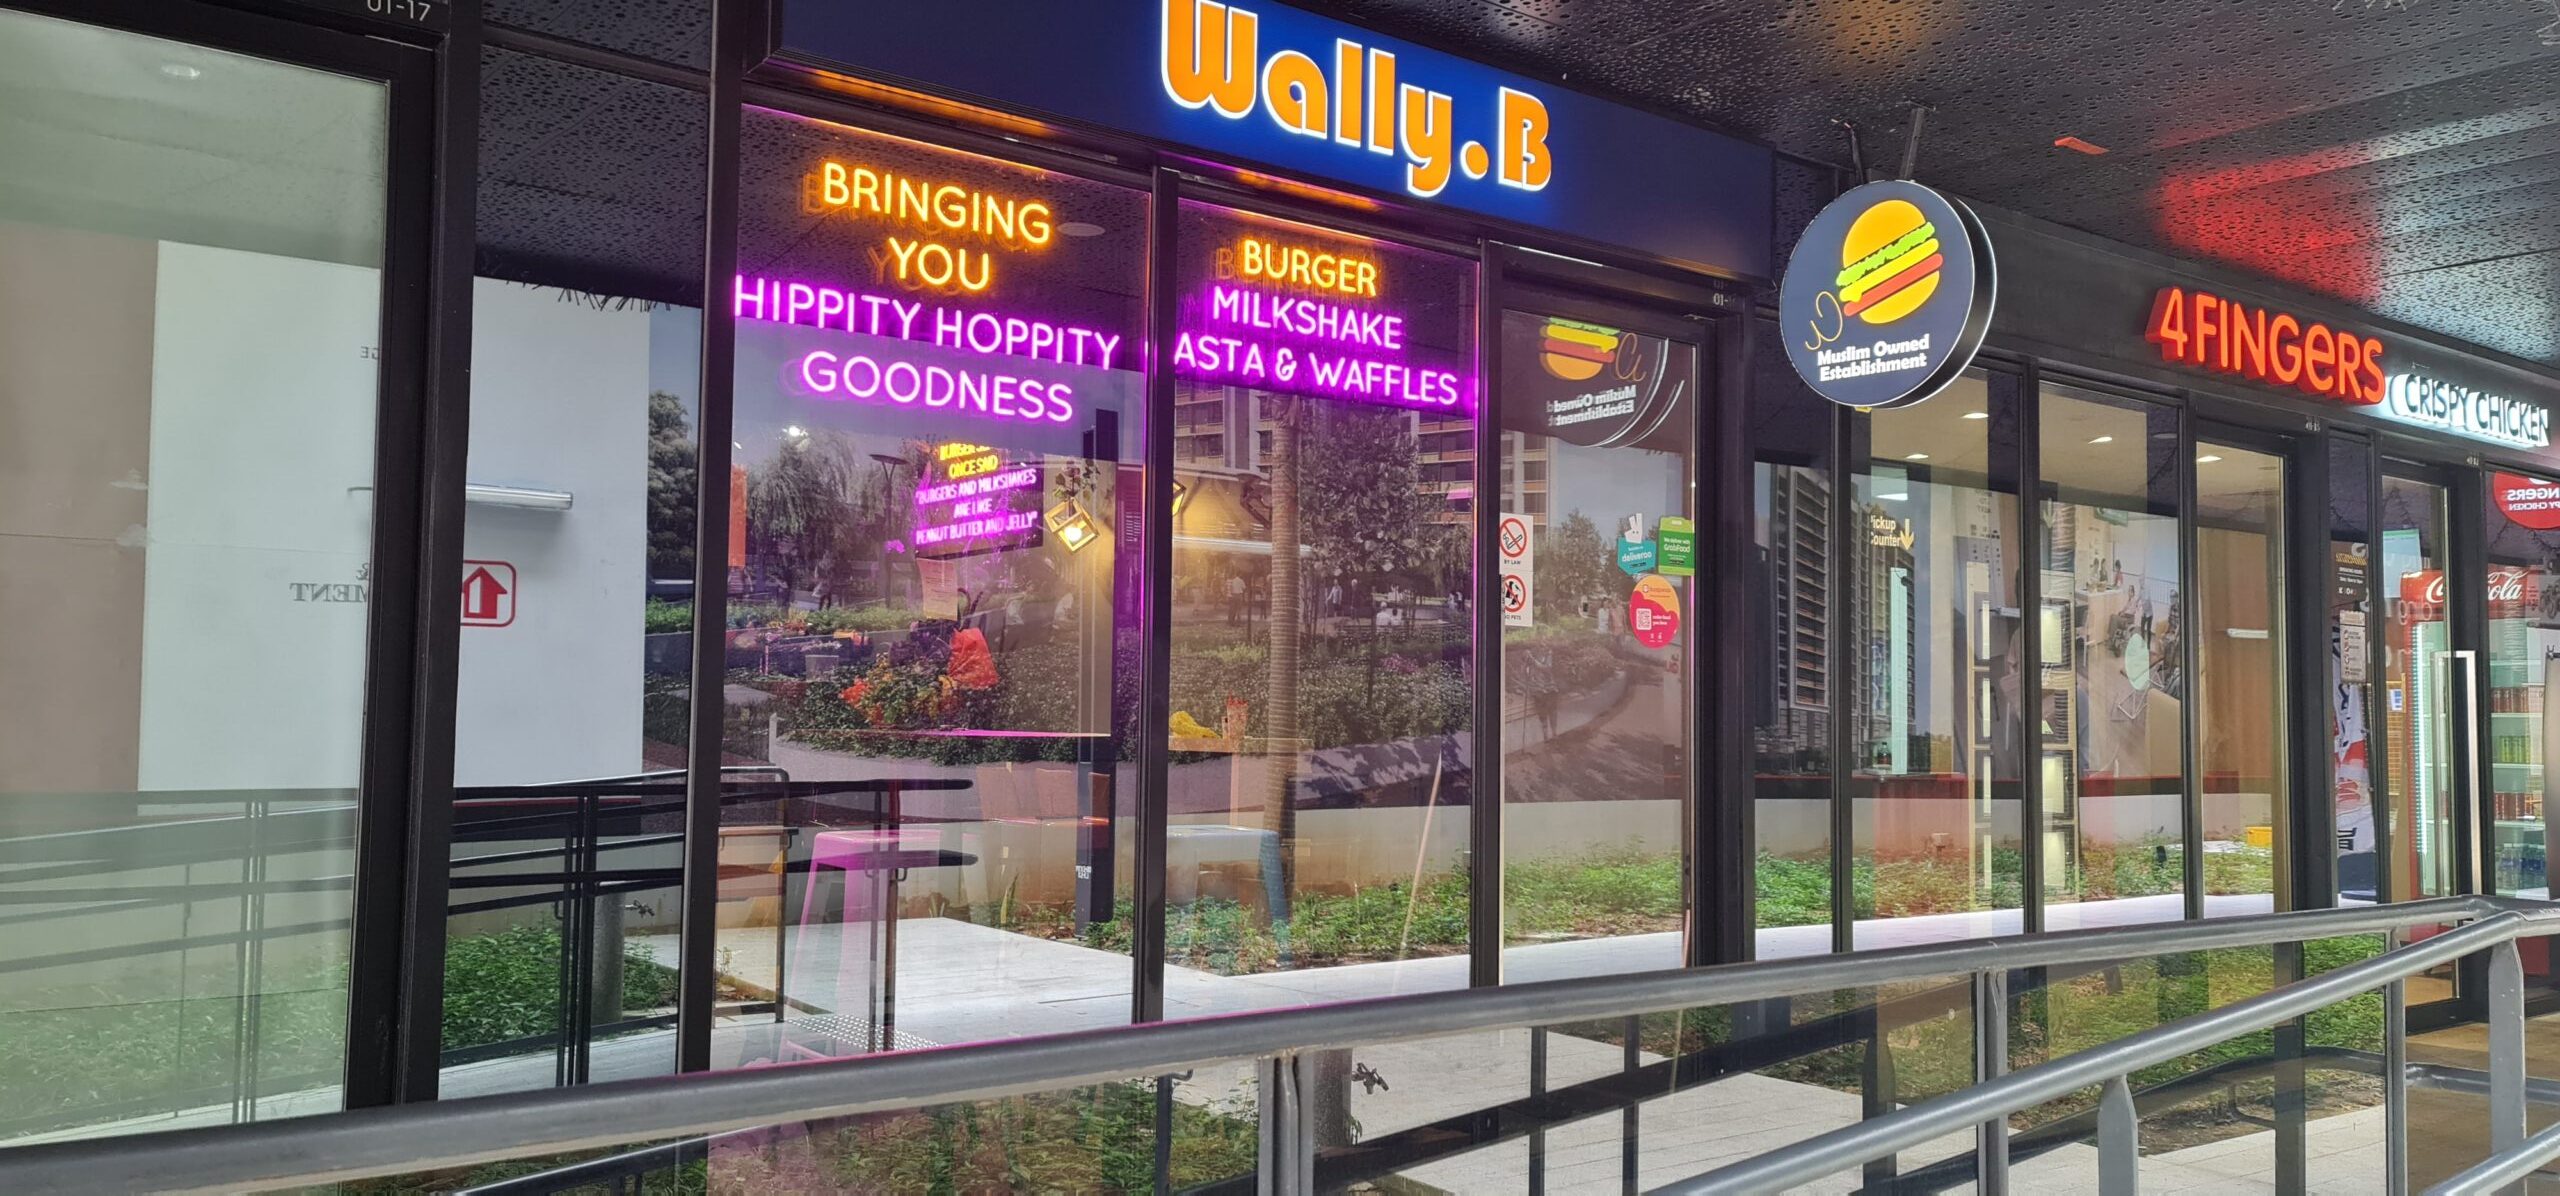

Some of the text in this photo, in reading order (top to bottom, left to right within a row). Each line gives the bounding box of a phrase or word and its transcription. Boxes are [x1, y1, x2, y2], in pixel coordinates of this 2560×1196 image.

[1161, 0, 1553, 198] Wally.B
[823, 161, 1052, 245] BRINGING
[888, 236, 991, 291] YOU
[1243, 239, 1377, 297] BURGER
[734, 274, 1121, 371] HIPPITY HOPPITY
[1212, 286, 1403, 350] MILKSHAKE
[1817, 334, 1930, 367] Muslim Owned
[802, 350, 1073, 423] GOODNESS
[1173, 332, 1459, 405] ASTA & WAFFLES
[1819, 352, 1928, 382] Establishment
[2398, 373, 2550, 446] CRISPY CHICKEN
